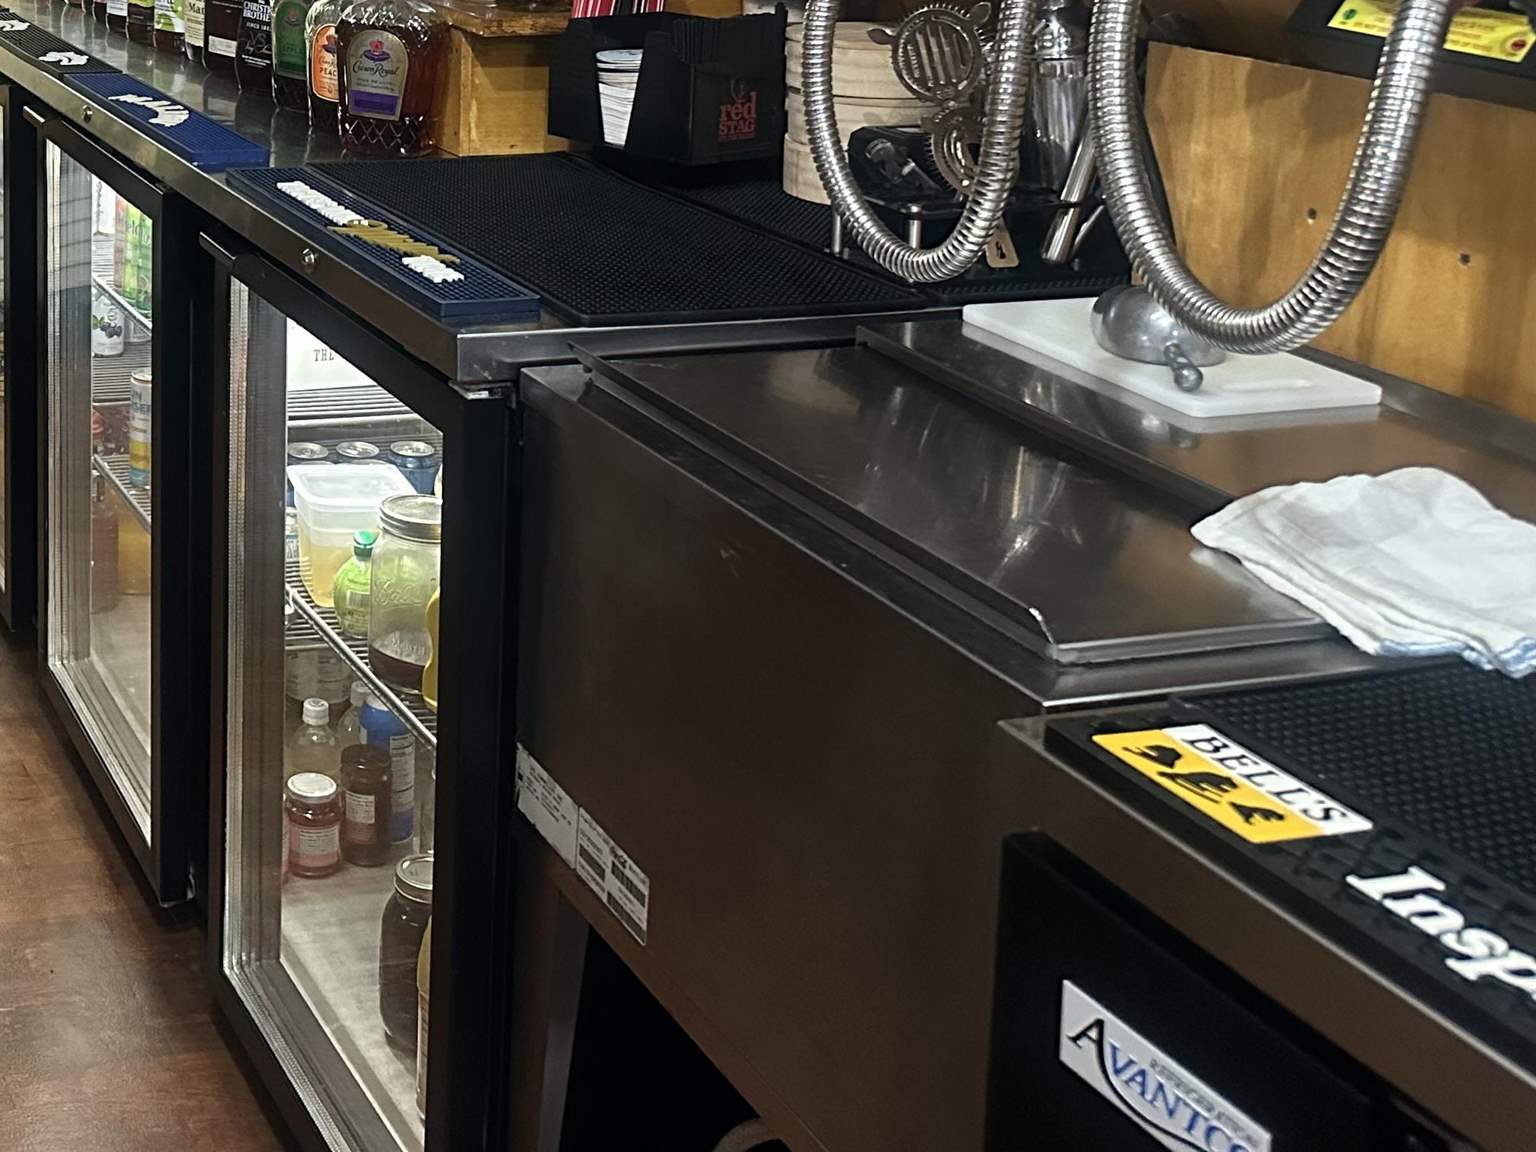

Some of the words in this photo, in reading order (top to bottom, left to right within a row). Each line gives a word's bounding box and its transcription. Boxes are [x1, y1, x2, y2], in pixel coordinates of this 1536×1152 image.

[243, 9, 272, 22] BROTHE
[319, 66, 337, 77] PEAC
[352, 60, 375, 75] Crown
[374, 61, 401, 78] Royal
[720, 91, 758, 121] red
[719, 119, 756, 136] STAG
[1181, 735, 1348, 823] BELL'S
